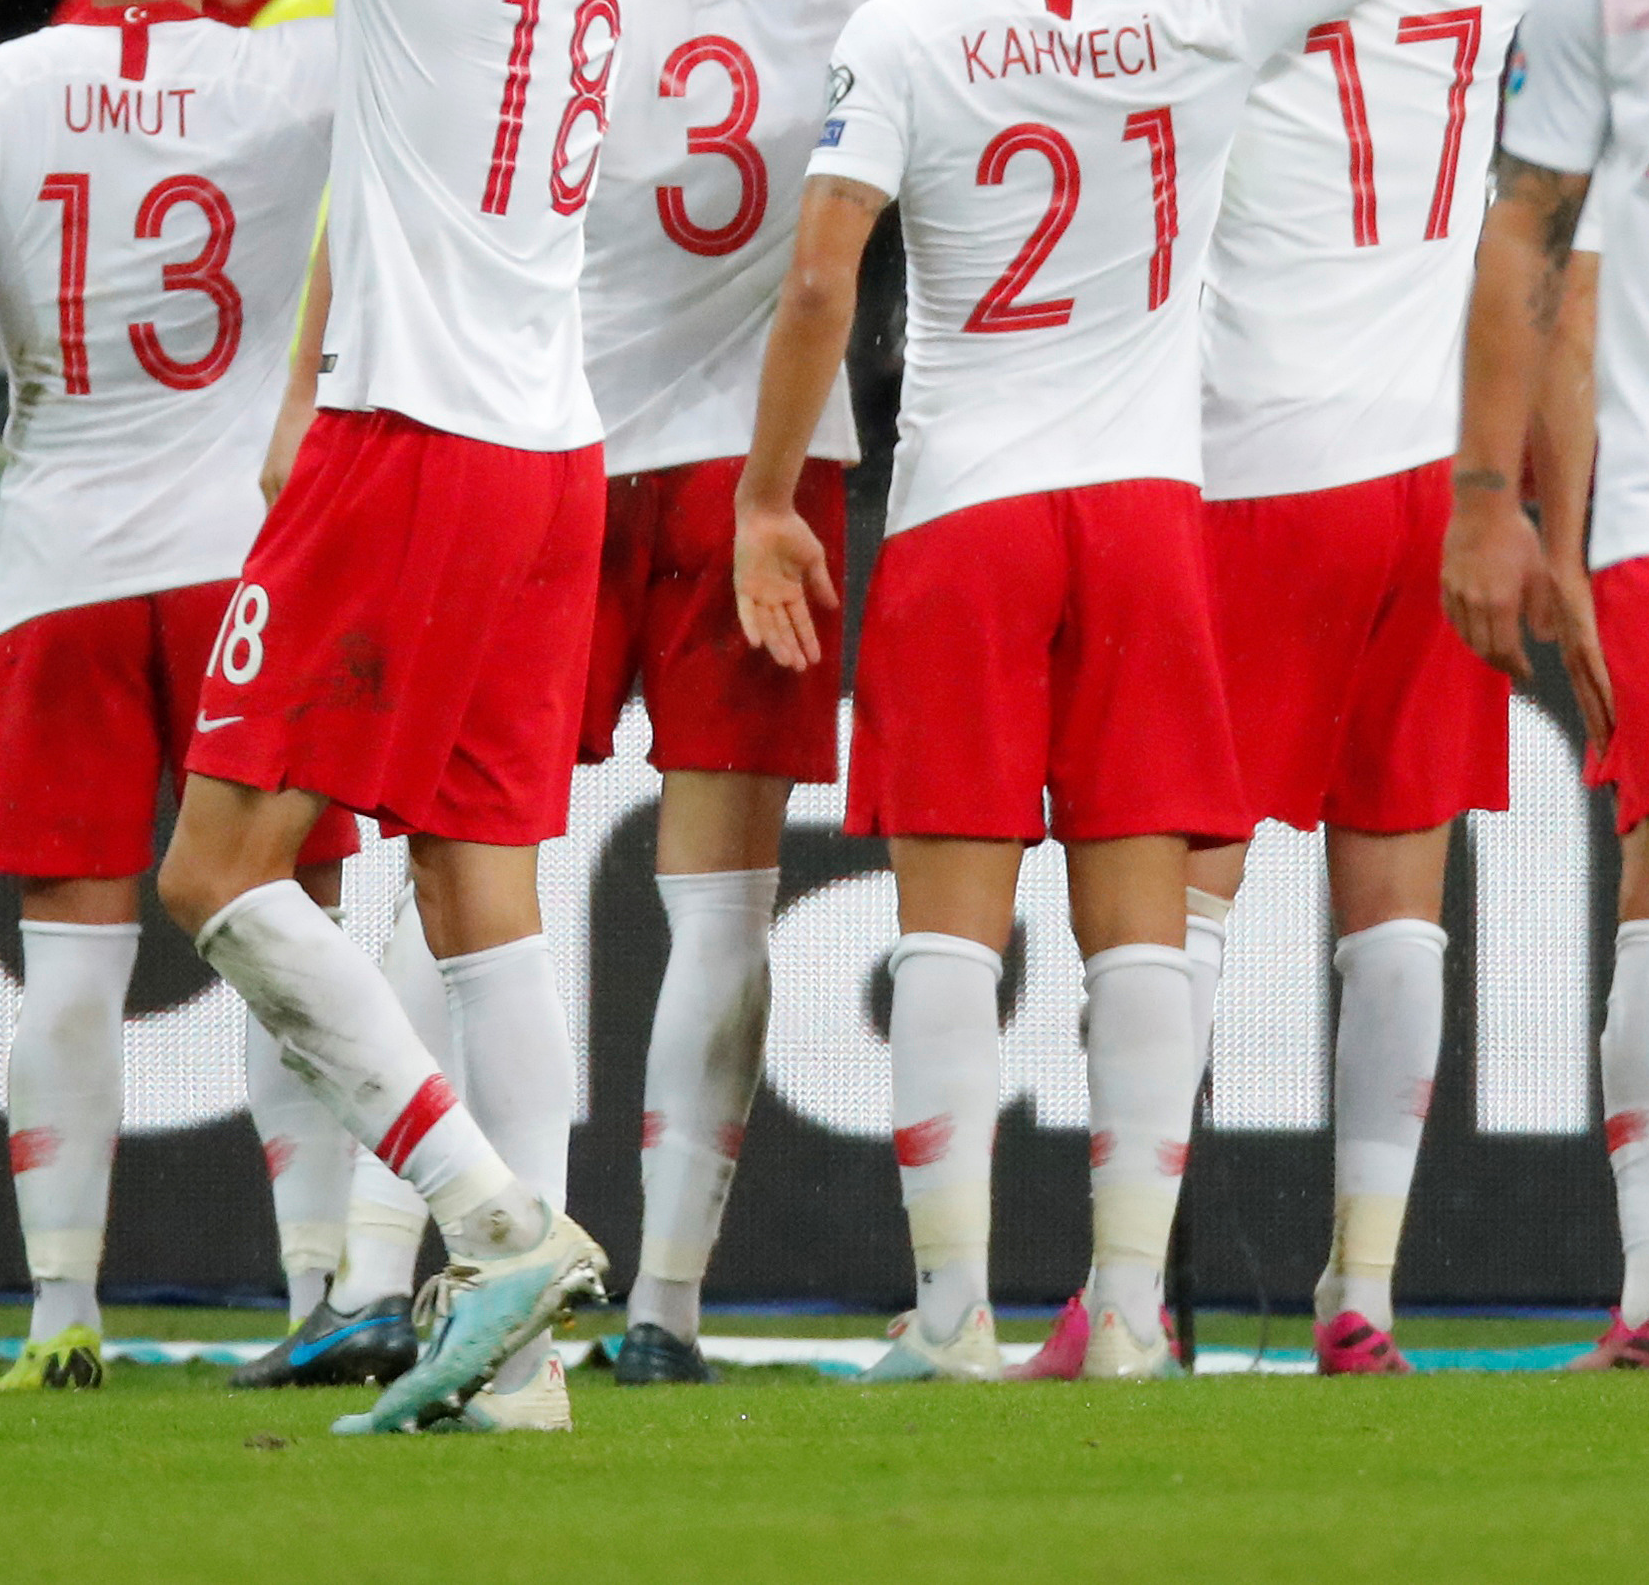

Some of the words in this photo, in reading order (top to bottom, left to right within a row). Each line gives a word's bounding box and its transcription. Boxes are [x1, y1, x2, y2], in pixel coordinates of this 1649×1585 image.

[65, 85, 196, 138] UMUT
[655, 33, 769, 257] 3
[962, 105, 1180, 335] 21
[1304, 6, 1482, 248] 17
[37, 171, 244, 397] 13
[207, 584, 270, 685] 18
